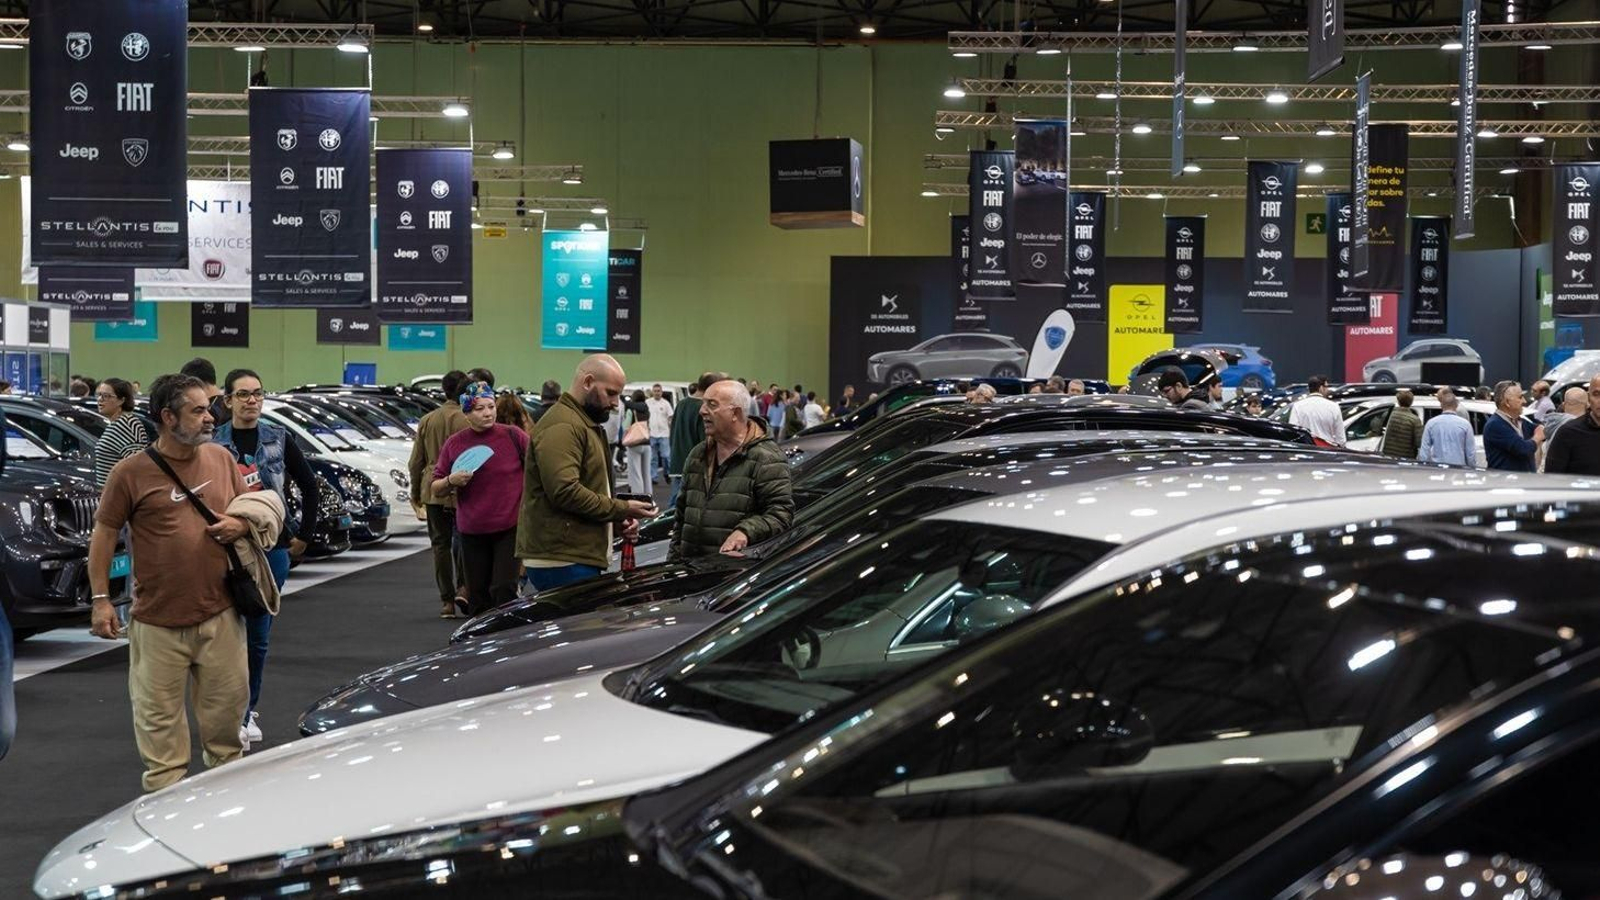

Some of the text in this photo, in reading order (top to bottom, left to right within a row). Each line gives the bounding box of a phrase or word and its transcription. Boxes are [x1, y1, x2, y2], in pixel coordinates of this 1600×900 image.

[117, 82, 154, 112] FIAT
[59, 143, 99, 161] Jeep
[316, 167, 344, 189] FIAT
[1389, 177, 1401, 185] de
[1380, 188, 1404, 196] sobre
[983, 191, 1004, 206] FIAT
[1260, 202, 1282, 217] FIAT
[1568, 203, 1590, 219] FIAT
[272, 213, 303, 227] Jeep
[428, 211, 452, 229] FIAT
[41, 221, 150, 232] STELLANTIS
[1075, 225, 1094, 240] FIAT
[109, 241, 144, 249] SERVICES
[980, 237, 1005, 249] Jeep
[393, 248, 419, 259] Jeep
[1176, 247, 1193, 260] FIAT
[1257, 249, 1282, 260] Jeep
[1421, 248, 1438, 260] FIAT
[1565, 251, 1592, 262] Jeep
[206, 263, 220, 275] FIAT
[1072, 266, 1095, 276] Jeep
[259, 273, 342, 281] STELLANTIS
[1174, 284, 1194, 292] Jeep
[1419, 286, 1439, 294] Jeep
[1370, 296, 1383, 317] AT
[221, 327, 239, 335] Jeep
[350, 321, 370, 330] Jeep
[575, 325, 596, 335] Jeep
[864, 325, 916, 333] AUTOMARES
[1350, 327, 1394, 335] AUTOMARES
[612, 332, 630, 340] Jeep
